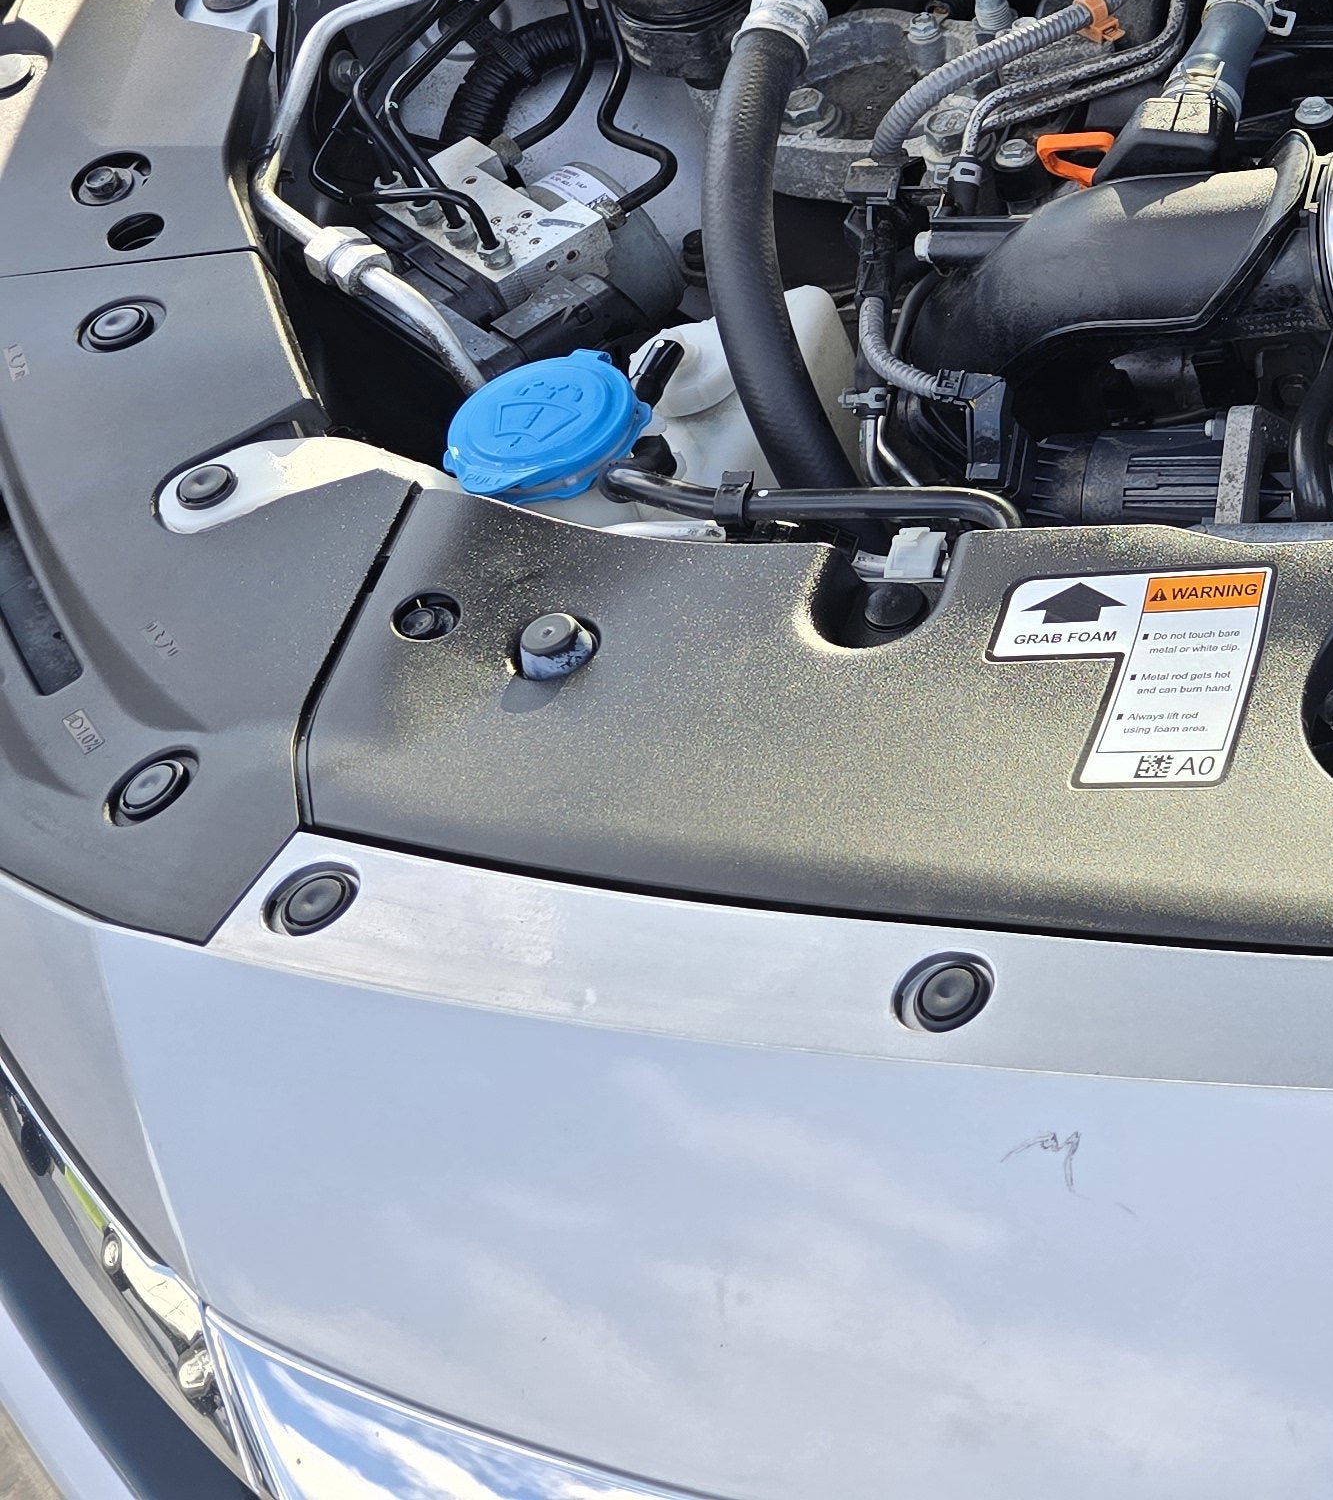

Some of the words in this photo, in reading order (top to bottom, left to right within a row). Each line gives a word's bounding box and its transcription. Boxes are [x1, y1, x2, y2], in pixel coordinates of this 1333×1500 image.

[1171, 583, 1258, 600] WARNING
[1014, 633, 1062, 645] GRAB
[1067, 630, 1118, 643] FOAM
[1153, 632, 1167, 641] Do
[1170, 631, 1186, 640] not
[1188, 630, 1215, 640] touch
[1218, 629, 1240, 637] bare
[1149, 646, 1177, 654] metal
[1192, 644, 1218, 653] white
[1220, 643, 1240, 653] clip.
[1141, 672, 1169, 681] Metal
[1171, 672, 1189, 680] rod
[1190, 671, 1212, 681] gets
[1214, 670, 1231, 679] hot
[1137, 686, 1156, 694] and
[1180, 685, 1203, 693] burn
[1205, 683, 1233, 692] hand.
[1127, 712, 1164, 722] Always
[1166, 712, 1180, 720] lift
[1181, 711, 1200, 719] rod
[1123, 725, 1151, 734] using
[1153, 725, 1180, 733] foam
[1174, 756, 1216, 776] A0
